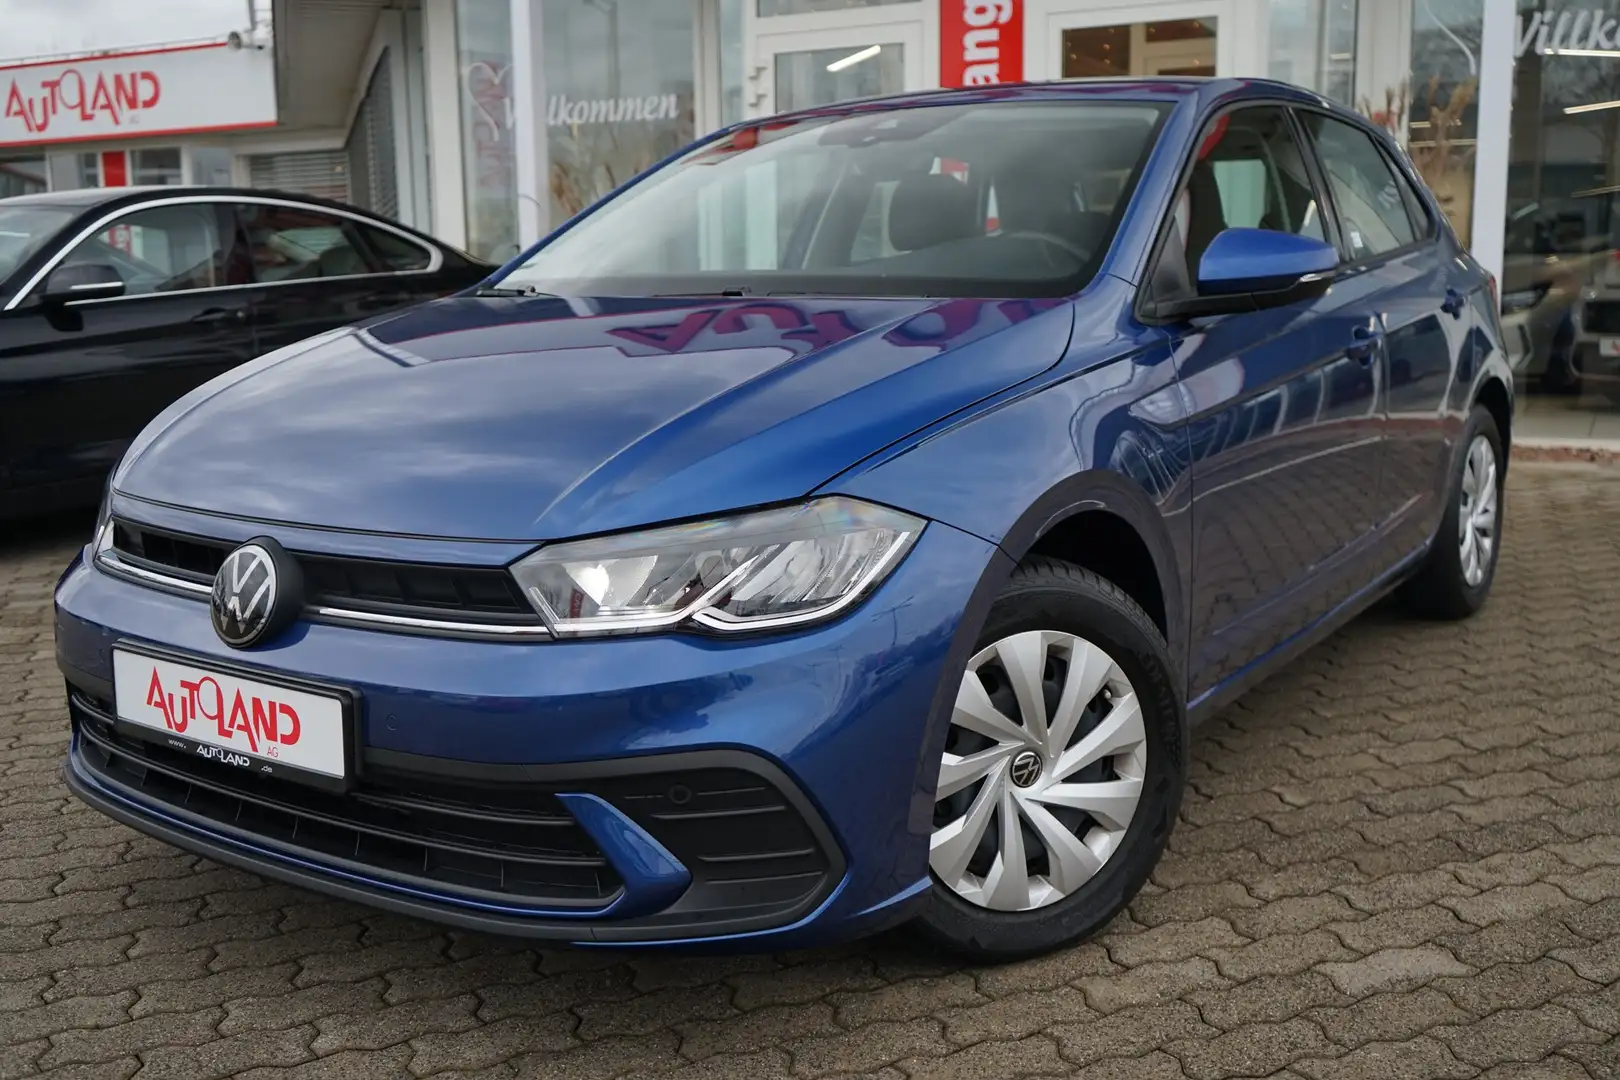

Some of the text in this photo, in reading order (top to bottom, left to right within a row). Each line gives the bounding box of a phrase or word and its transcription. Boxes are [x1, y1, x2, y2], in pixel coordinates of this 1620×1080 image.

[1514, 8, 1620, 57] illk
[504, 94, 679, 130] lkommen
[147, 666, 300, 752] AUTOLAND
[261, 764, 273, 773] .de
[267, 745, 279, 758] AG
